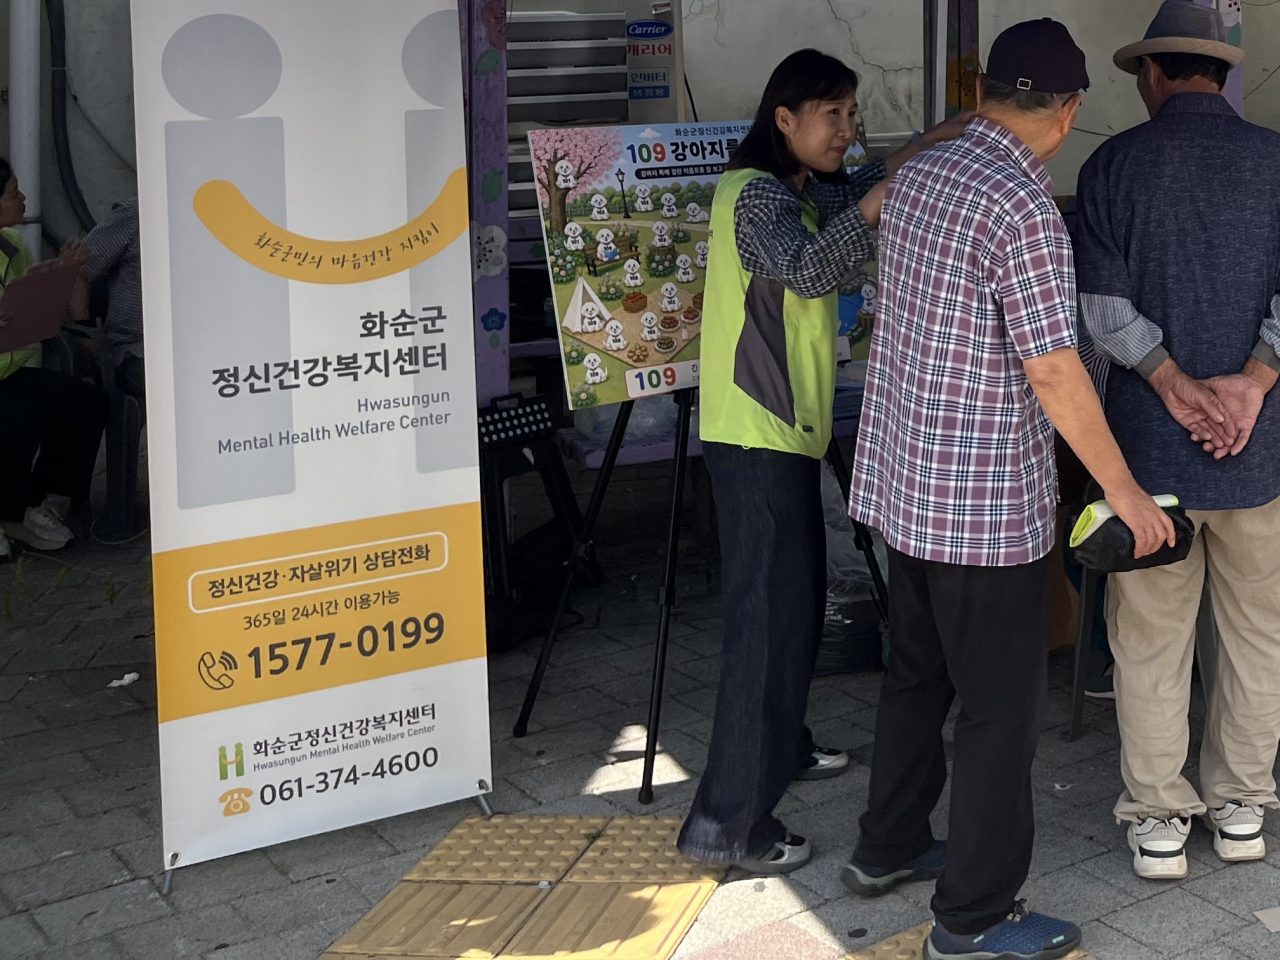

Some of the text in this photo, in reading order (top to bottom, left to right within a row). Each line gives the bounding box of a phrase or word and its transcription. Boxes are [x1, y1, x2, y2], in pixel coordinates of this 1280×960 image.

[628, 24, 668, 34] Carrier
[627, 142, 666, 163] 109
[253, 221, 440, 270] 화순군민의 마음건강 지킴이
[359, 305, 447, 340] 화순군
[212, 342, 448, 398] 정신건강복지센터
[634, 367, 677, 390] 109
[357, 391, 450, 413] Hwasungun
[218, 411, 452, 454] Mental Health Welfare Center
[362, 543, 432, 572] 상담전화
[243, 589, 401, 631] 365일 24시간 이용가능
[247, 611, 446, 679] 1577-0199
[252, 702, 437, 758] 화순군정신건강복지센터
[253, 724, 436, 772] Hwasungun Mental Health Welfare Center
[259, 746, 439, 806] 061-374-4600
